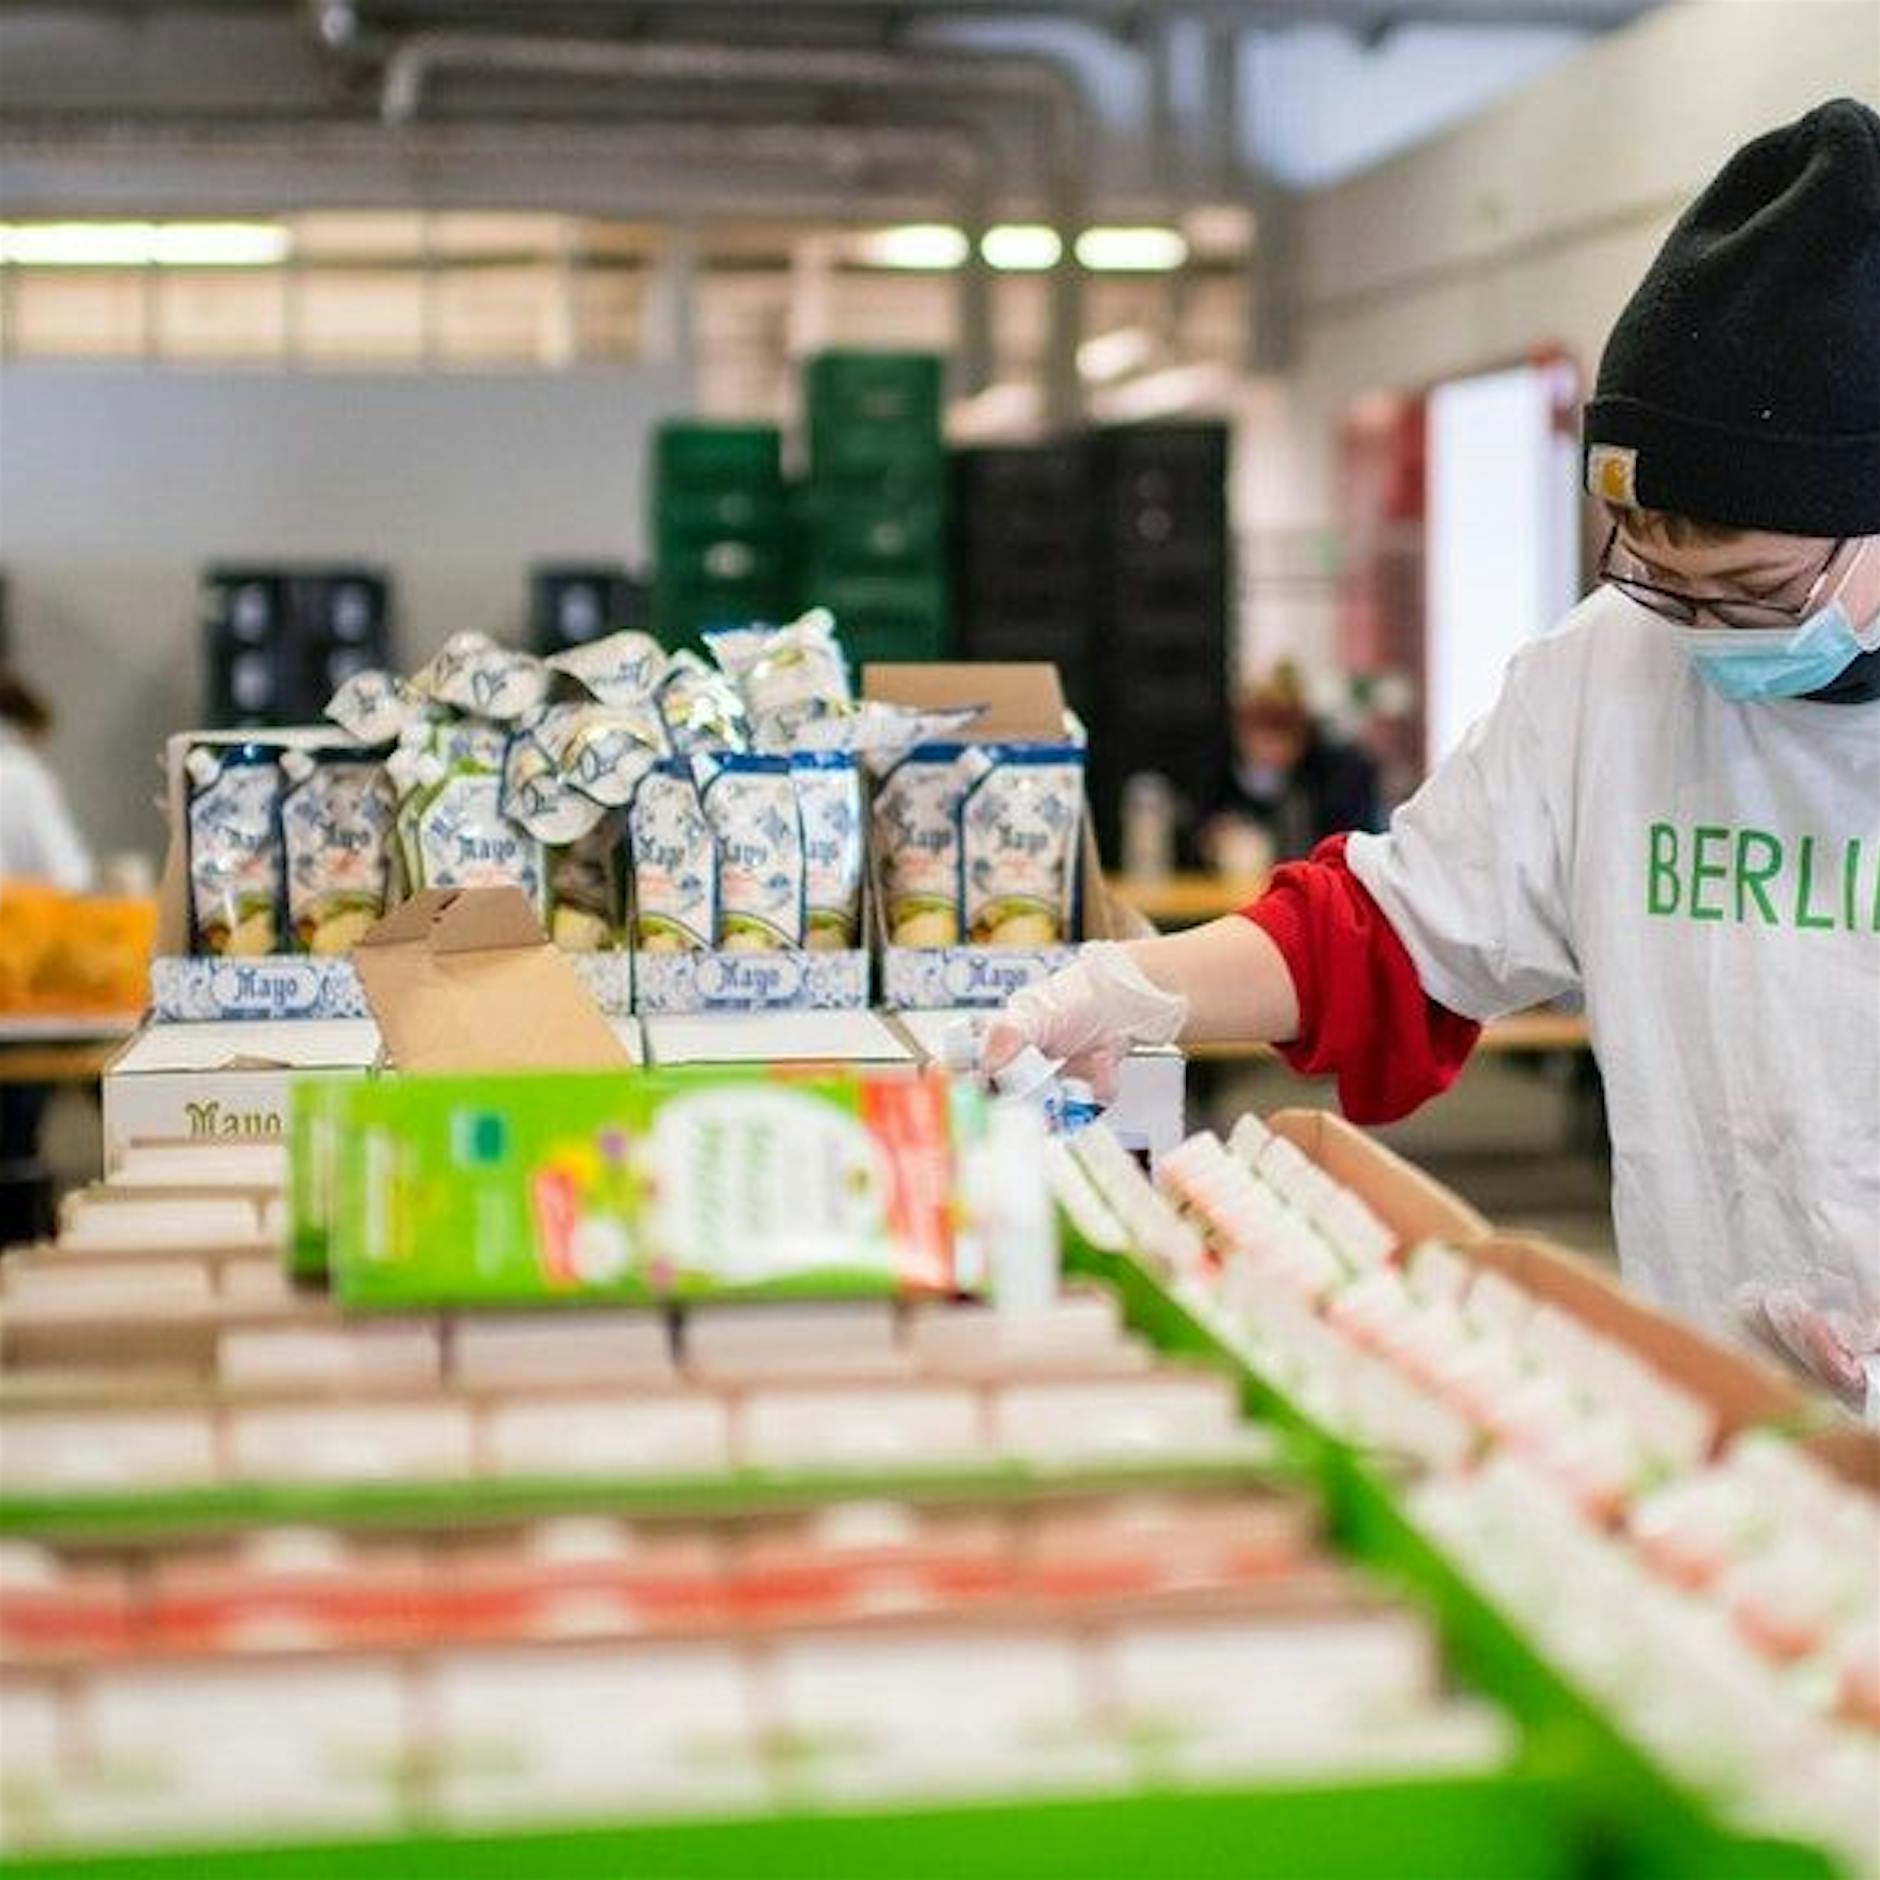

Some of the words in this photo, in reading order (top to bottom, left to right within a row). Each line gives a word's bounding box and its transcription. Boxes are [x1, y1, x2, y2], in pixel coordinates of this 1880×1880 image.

[457, 834, 517, 865] Mayo
[809, 841, 839, 867] ayo
[236, 967, 298, 1006] Mayo
[716, 959, 781, 996] Mayo
[965, 956, 1029, 996] Mayo
